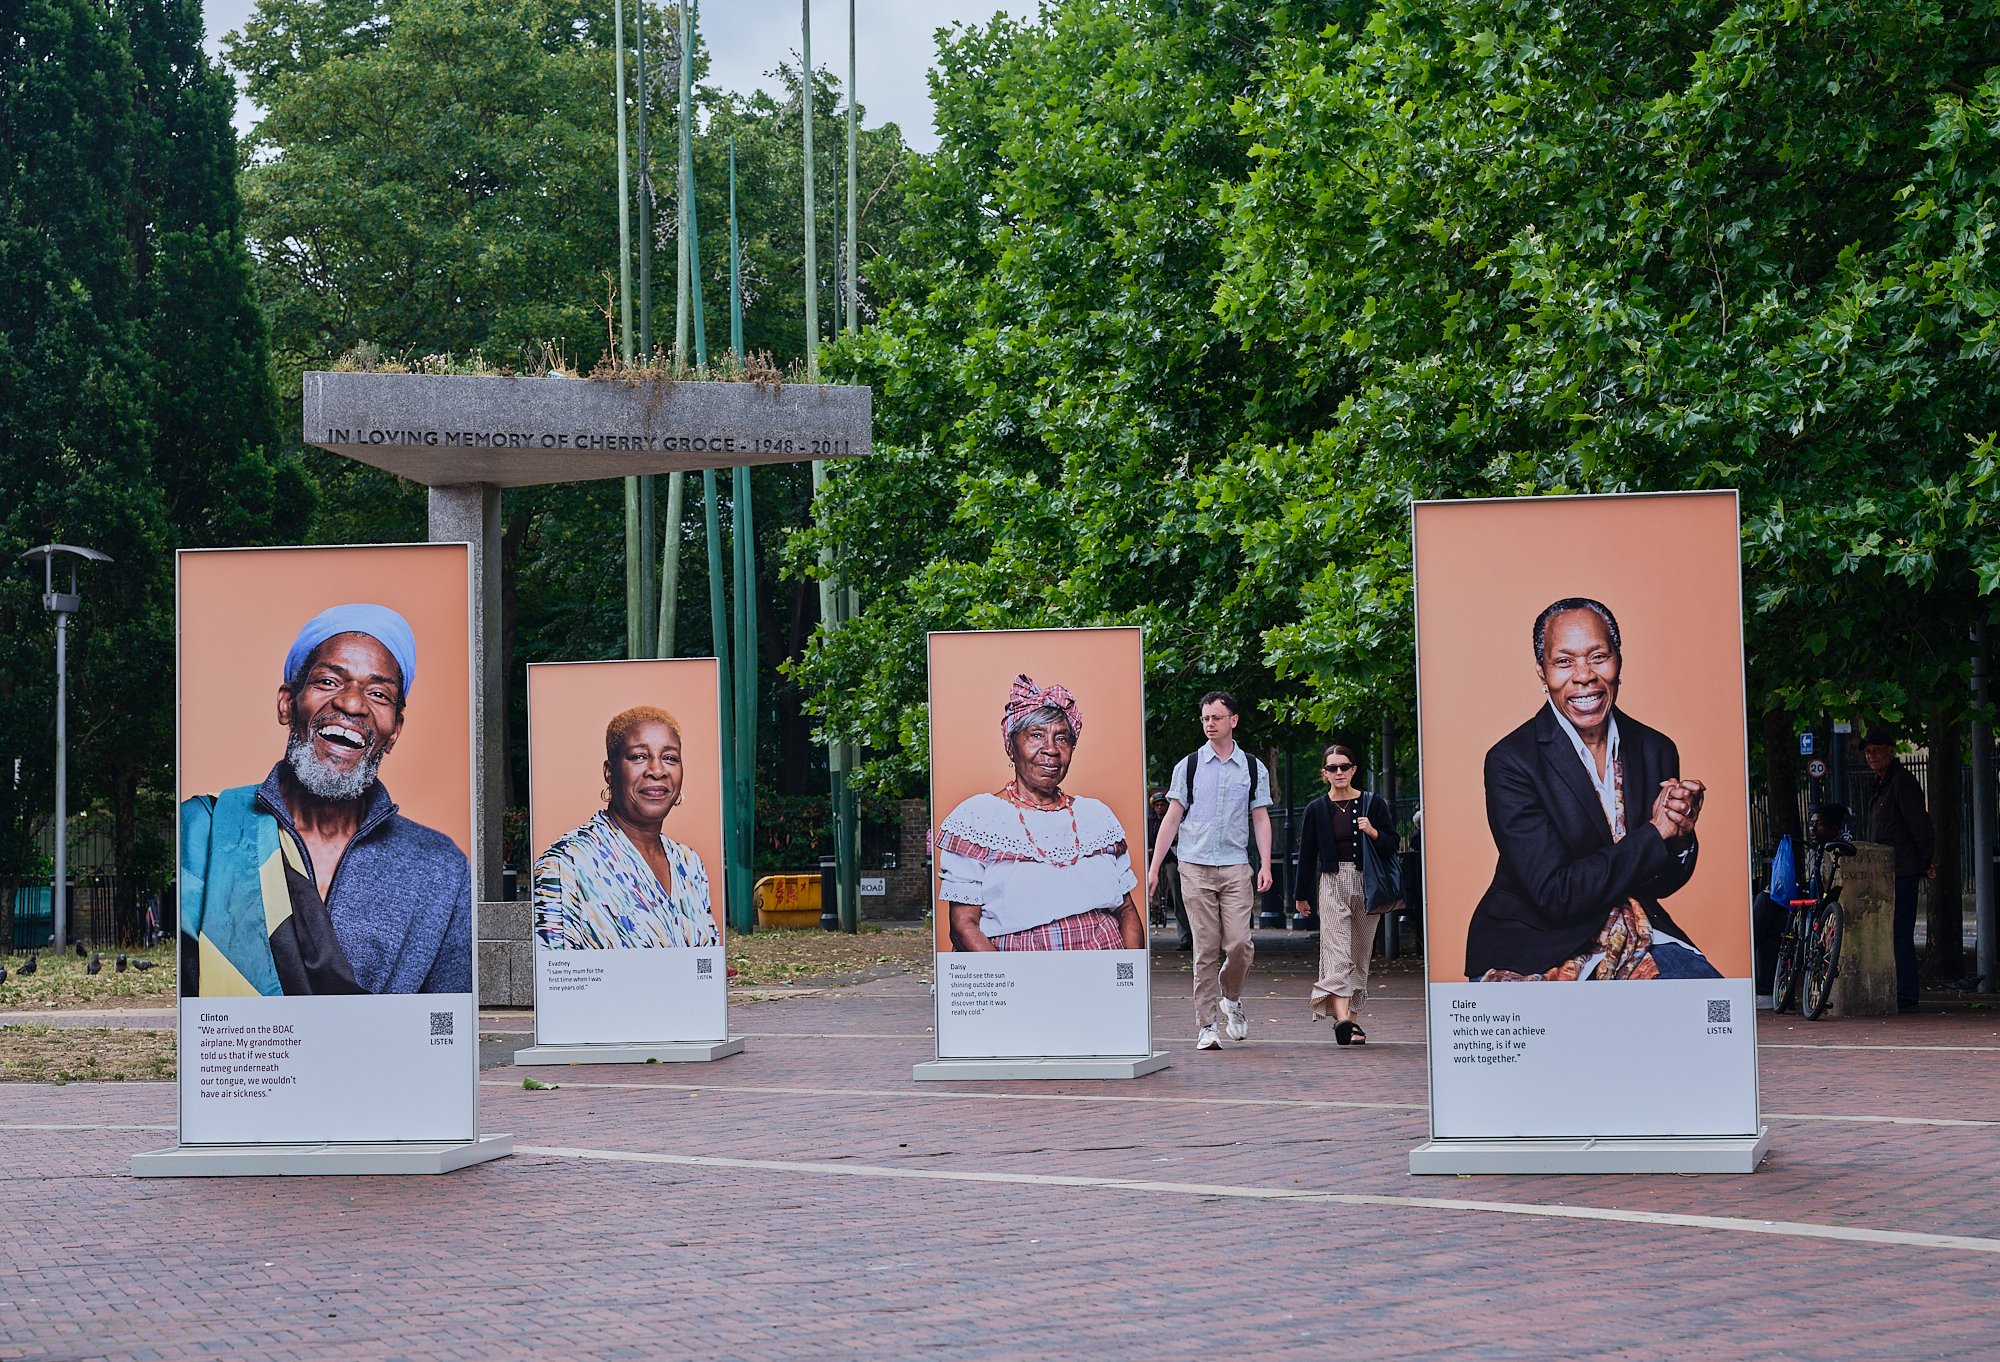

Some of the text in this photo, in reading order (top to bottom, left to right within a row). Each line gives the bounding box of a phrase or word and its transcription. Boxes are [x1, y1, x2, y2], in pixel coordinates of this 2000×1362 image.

[328, 429, 350, 444] IN
[357, 430, 438, 446] LOVING
[445, 431, 534, 448] MEMORY
[541, 434, 568, 449] OF
[575, 435, 656, 451] CHERRY
[663, 437, 735, 452] GROCE
[754, 439, 793, 454] 1948
[811, 440, 849, 455] 2011
[1810, 763, 1825, 773] 20
[861, 884, 884, 892] ROAD
[950, 963, 967, 971] Daisy
[950, 981, 972, 990] shining
[977, 990, 990, 998] only
[1452, 1000, 1477, 1009] Claire
[200, 1013, 229, 1022] Clinton
[1472, 1013, 1491, 1024] only
[1492, 1014, 1510, 1024] way
[1512, 1012, 1521, 1022] in
[216, 1025, 244, 1034] arrived
[257, 1025, 271, 1034] the
[272, 1025, 294, 1034] BOAC
[1452, 1026, 1546, 1036] which we can achieve
[1706, 1026, 1733, 1035] LISTEN
[200, 1037, 302, 1049] airplane. My grandmother
[1453, 1040, 1526, 1052] anything, is if we
[200, 1051, 217, 1060] told
[229, 1052, 246, 1060] that
[247, 1051, 254, 1059] if
[268, 1050, 290, 1059] stuck
[1453, 1054, 1476, 1063] work
[200, 1063, 279, 1074] nutmeg underneath
[215, 1077, 246, 1087] tongue,
[247, 1077, 260, 1085] we
[261, 1075, 297, 1085] wouldn't
[200, 1089, 220, 1098] have
[221, 1089, 232, 1098] air
